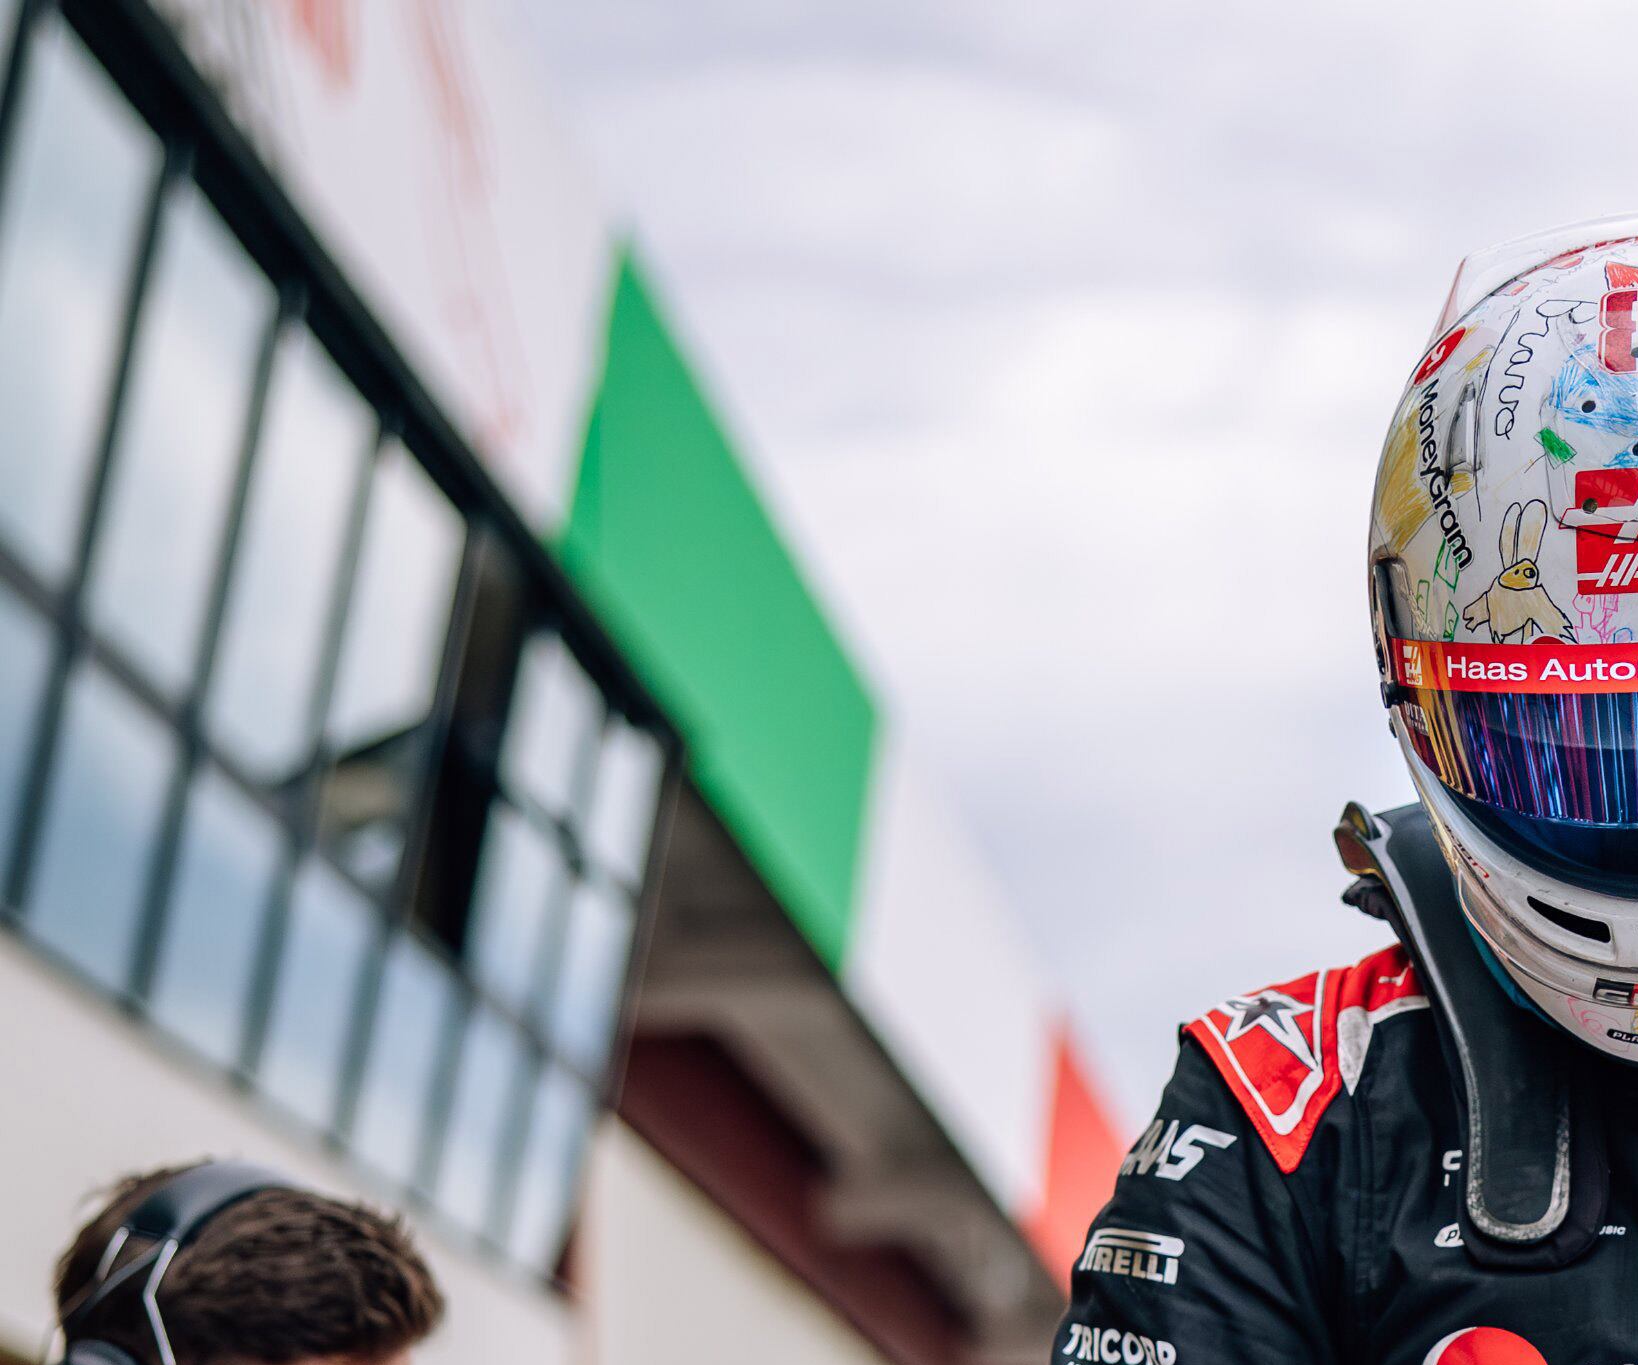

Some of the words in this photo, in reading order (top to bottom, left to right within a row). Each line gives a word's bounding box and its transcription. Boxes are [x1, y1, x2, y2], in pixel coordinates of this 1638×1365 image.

[1419, 377, 1473, 570] MoneyGram
[1446, 655, 1527, 681] Haas
[1078, 1227, 1185, 1285] PIRELLI
